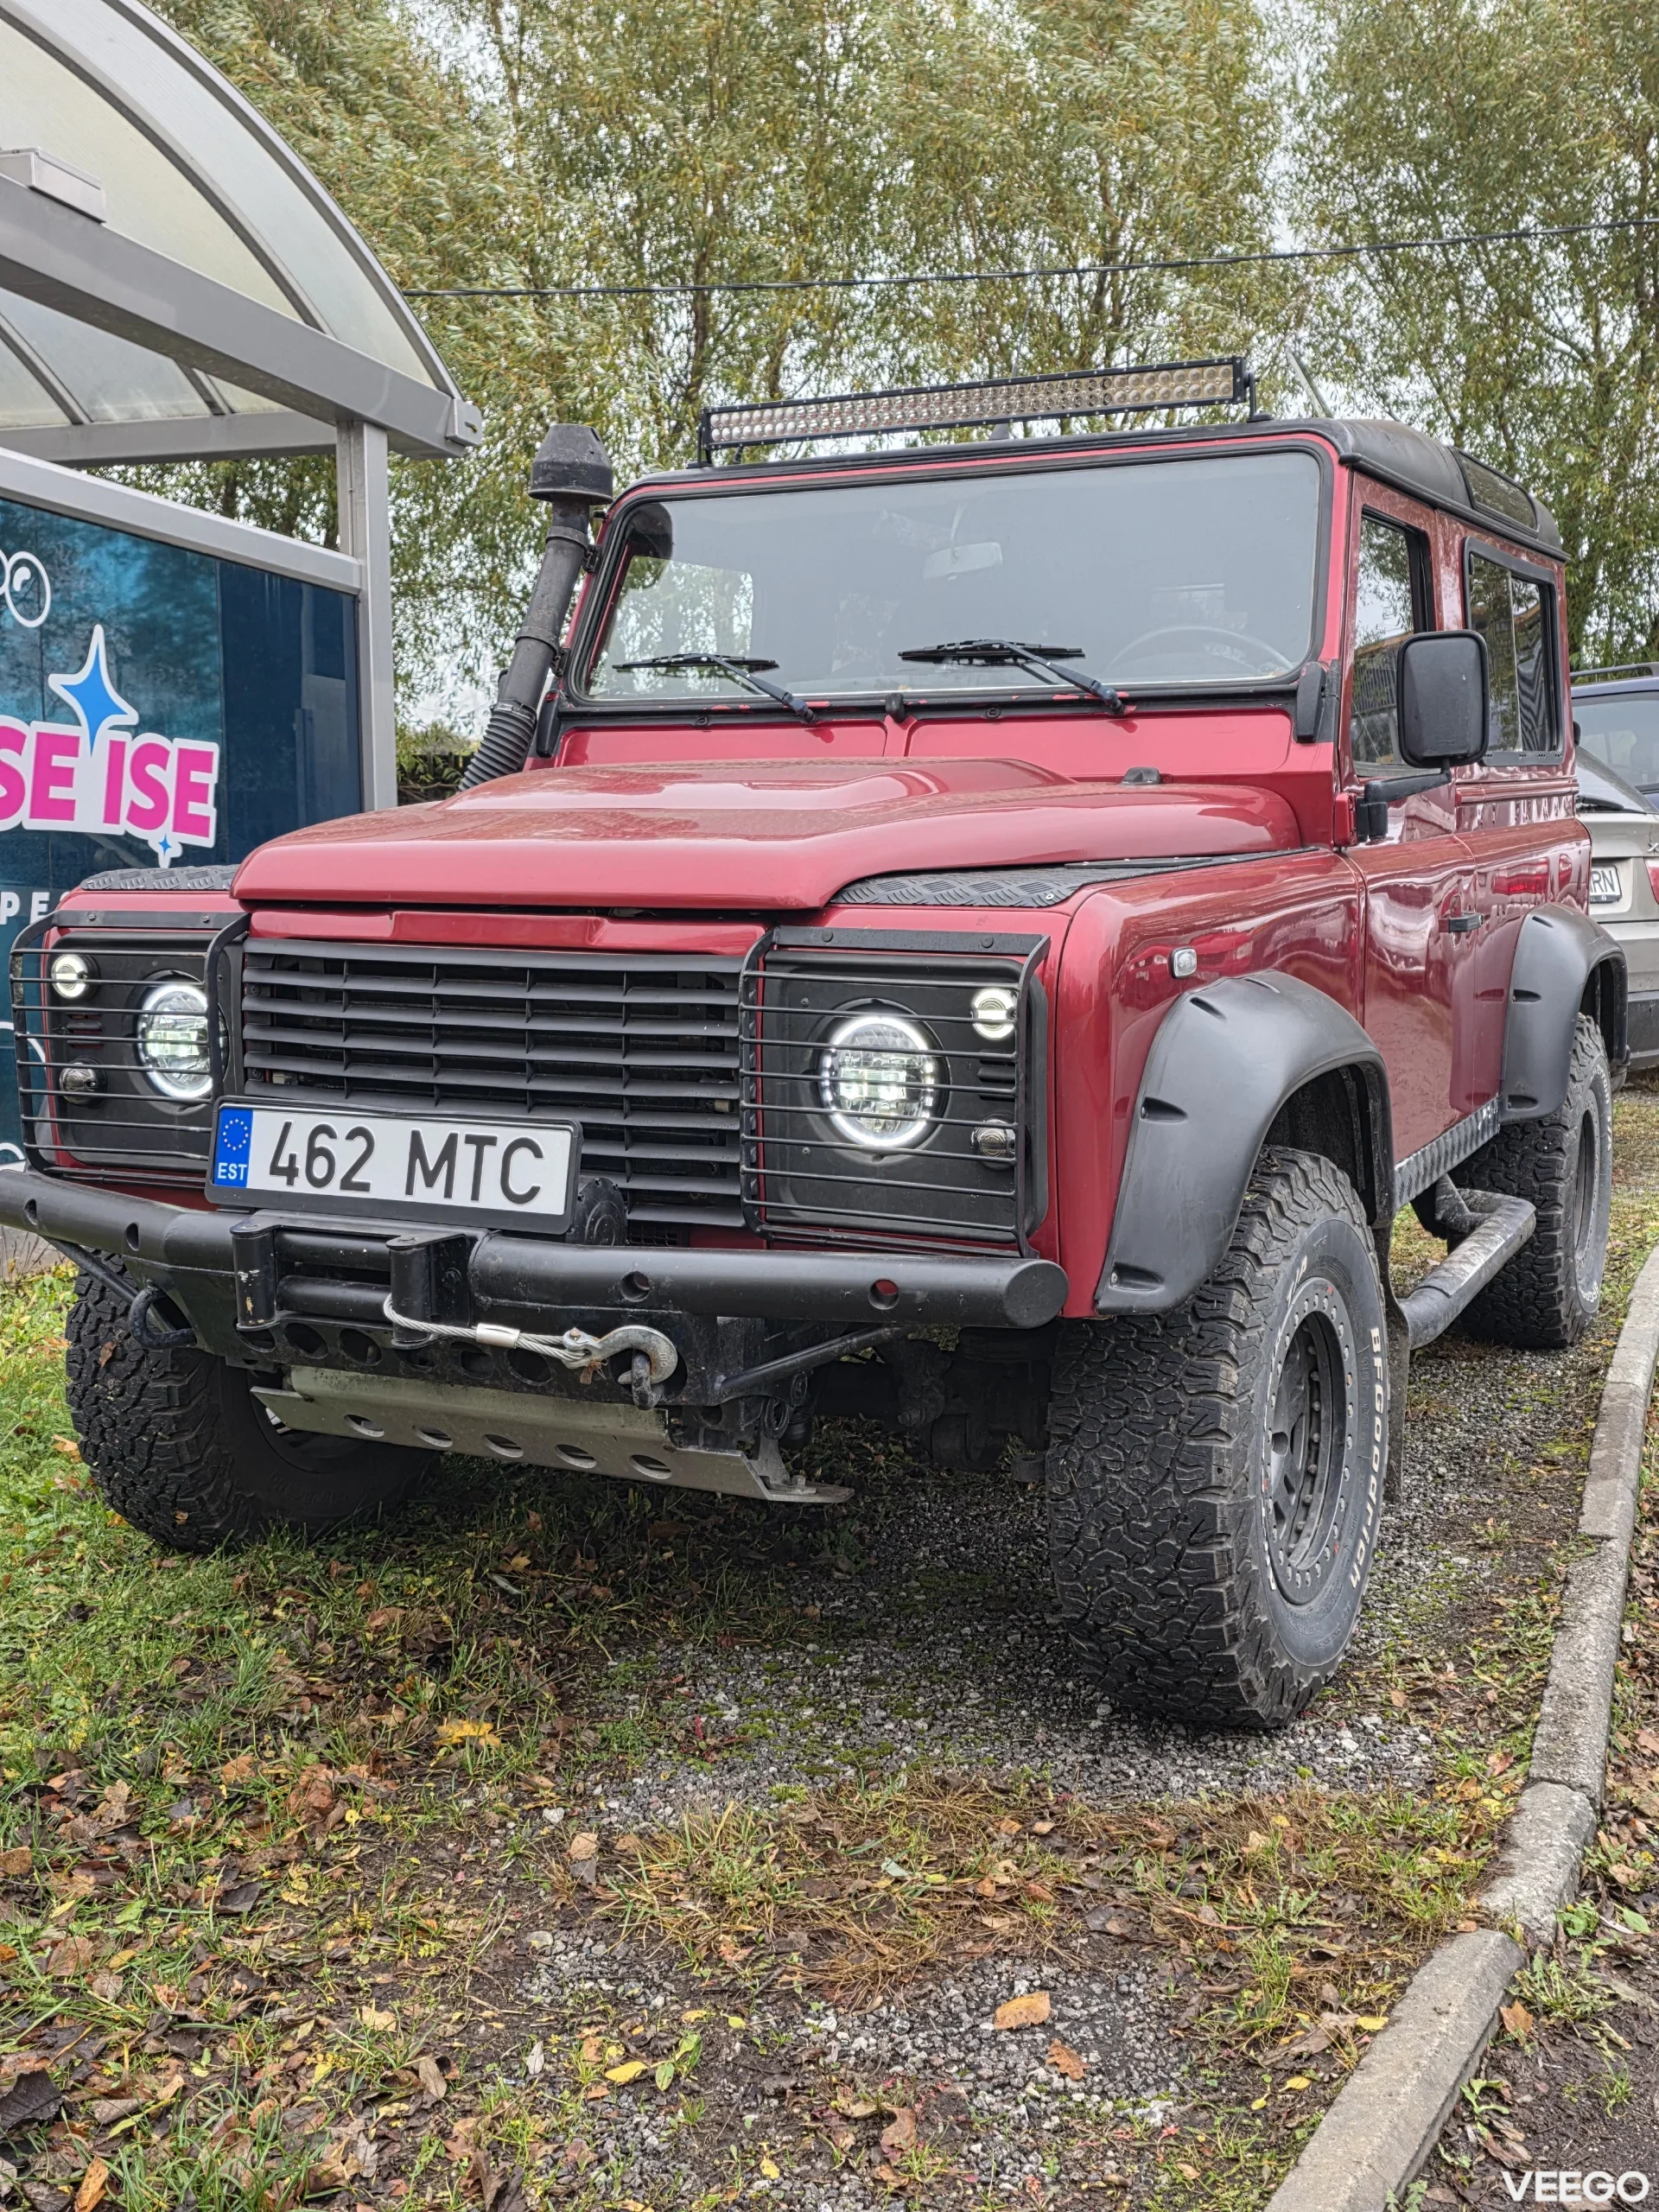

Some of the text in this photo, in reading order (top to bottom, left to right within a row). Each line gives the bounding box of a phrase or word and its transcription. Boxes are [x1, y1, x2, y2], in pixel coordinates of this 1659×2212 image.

[102, 739, 214, 839] ISE
[0, 892, 70, 925] PE
[1591, 869, 1616, 893] RN
[218, 1162, 247, 1180] EST
[269, 1121, 543, 1205] 462 MTC
[1349, 1327, 1384, 1589] BFGoodrich
